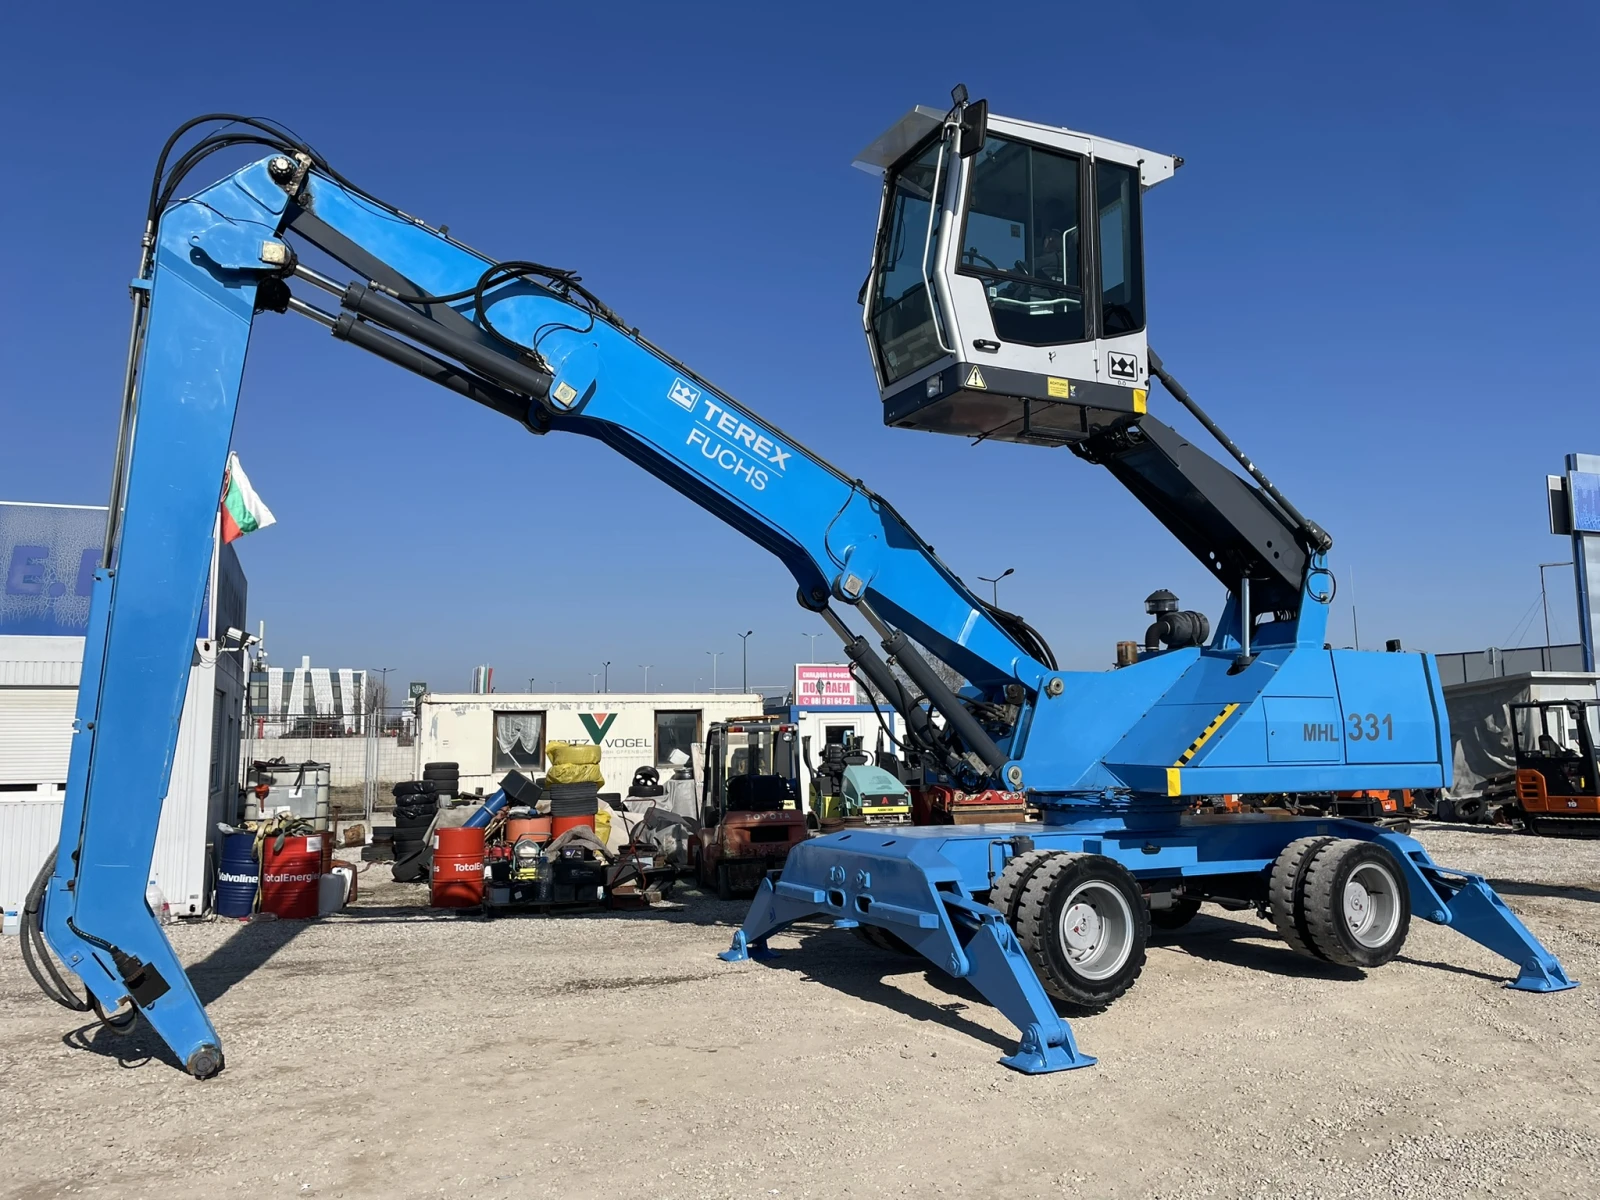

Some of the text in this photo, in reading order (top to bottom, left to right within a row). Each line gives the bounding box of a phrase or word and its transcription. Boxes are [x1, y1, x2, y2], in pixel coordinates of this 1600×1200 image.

[704, 399, 792, 471] TEREX
[686, 428, 769, 491] FUCHS
[802, 682, 822, 694] ПО
[1303, 713, 1393, 742] MHL 331
[605, 738, 652, 748] VOGEL
[745, 812, 791, 821] TOYOTA
[218, 871, 259, 883] Valvoline
